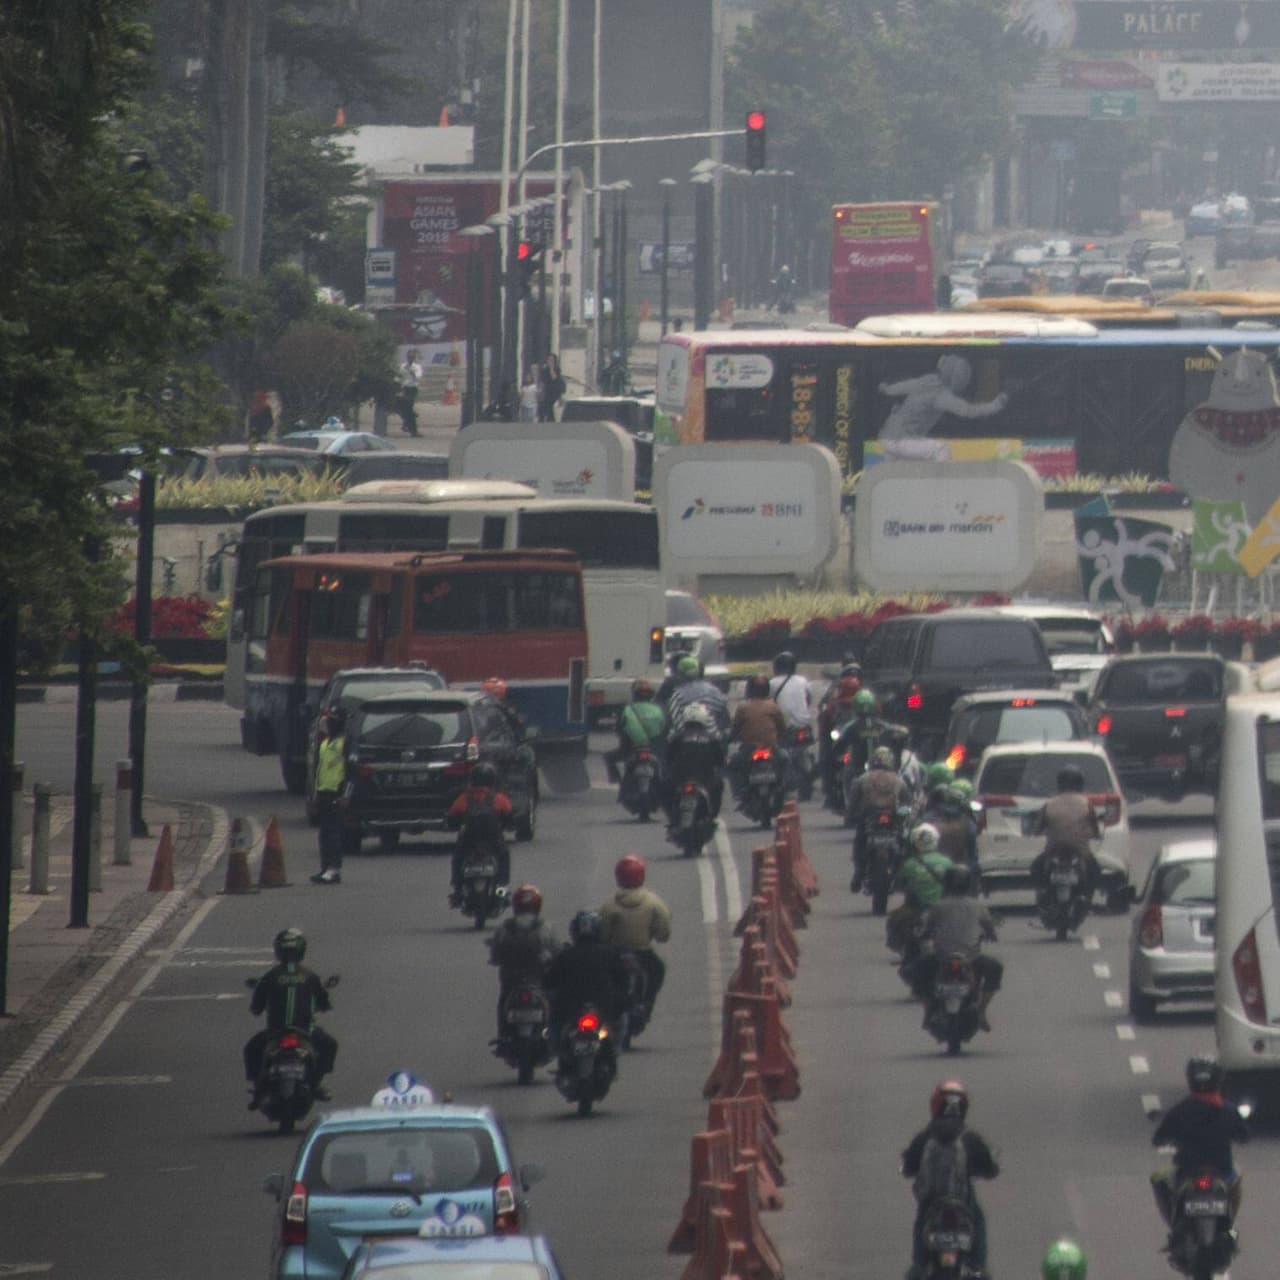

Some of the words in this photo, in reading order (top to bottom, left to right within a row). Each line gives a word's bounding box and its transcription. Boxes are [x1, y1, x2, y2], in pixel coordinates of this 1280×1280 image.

[1123, 12, 1201, 33] PALACE
[409, 218, 459, 231] GAMES
[416, 231, 449, 244] 2018
